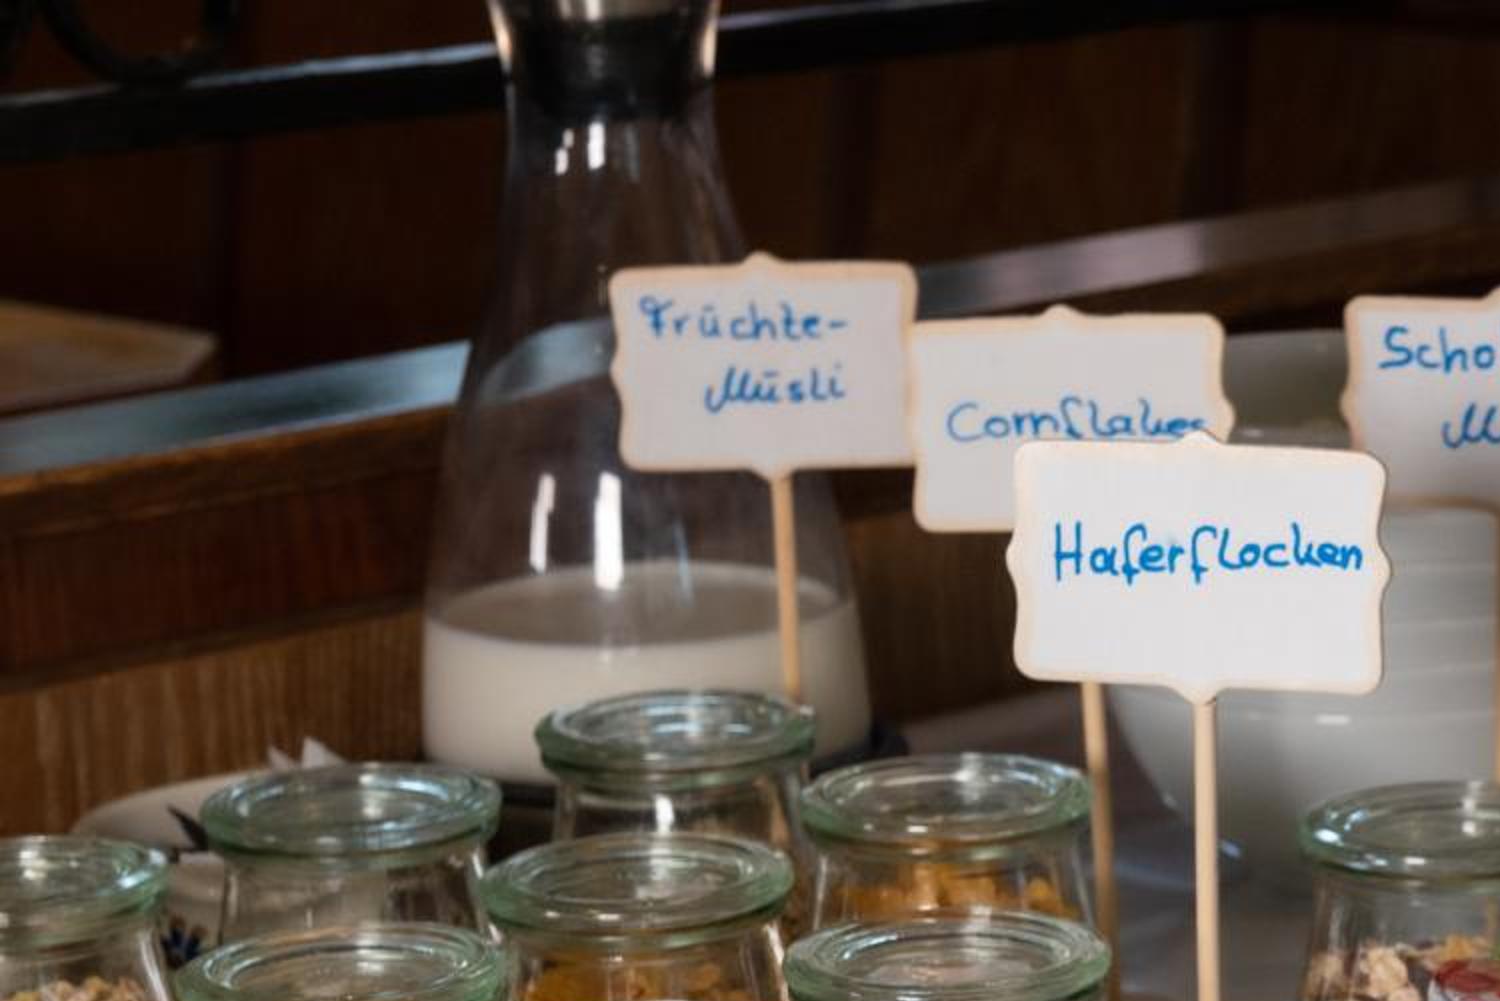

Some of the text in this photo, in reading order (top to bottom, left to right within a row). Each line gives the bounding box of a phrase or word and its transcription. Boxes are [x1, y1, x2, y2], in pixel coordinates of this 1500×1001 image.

[638, 296, 849, 340] Früchte-
[704, 362, 847, 414] Müsli
[1053, 521, 1365, 586] Haferflocken
